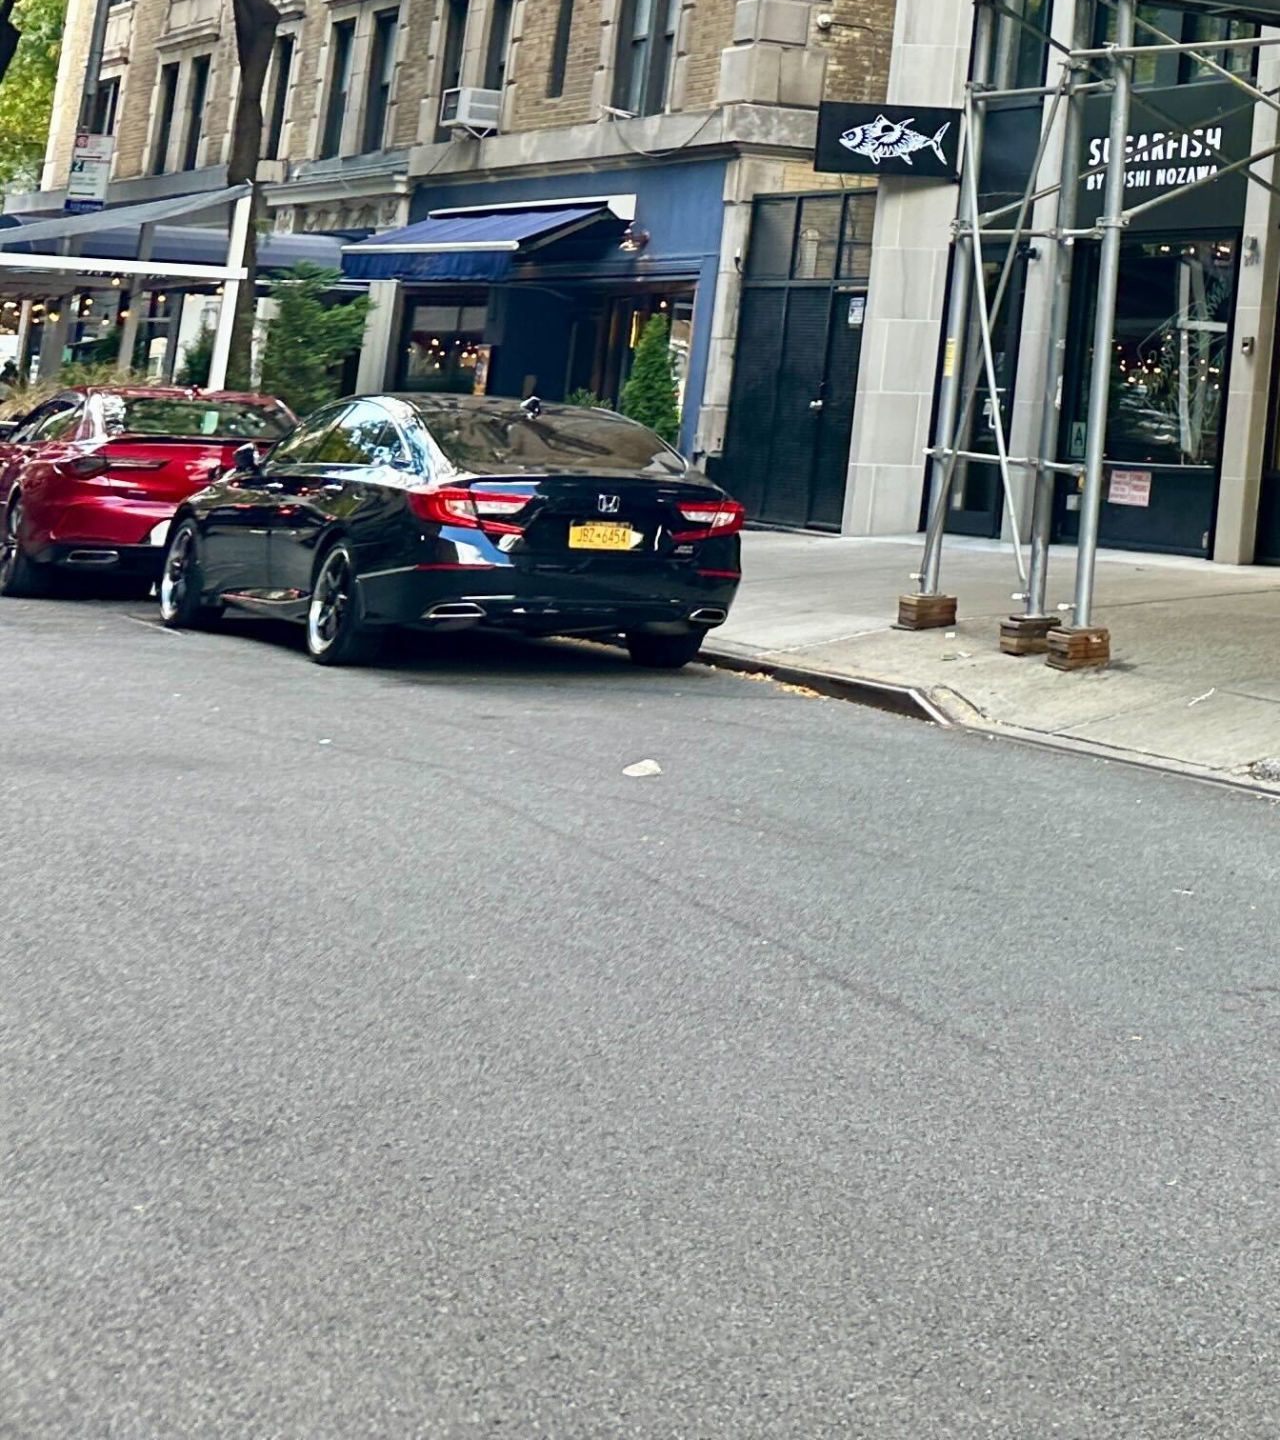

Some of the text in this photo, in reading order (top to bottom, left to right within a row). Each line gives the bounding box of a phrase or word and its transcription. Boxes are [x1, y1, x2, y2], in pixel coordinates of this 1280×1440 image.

[1086, 173, 1105, 191] BY
[1123, 170, 1151, 188] SHI
[1073, 426, 1083, 446] A
